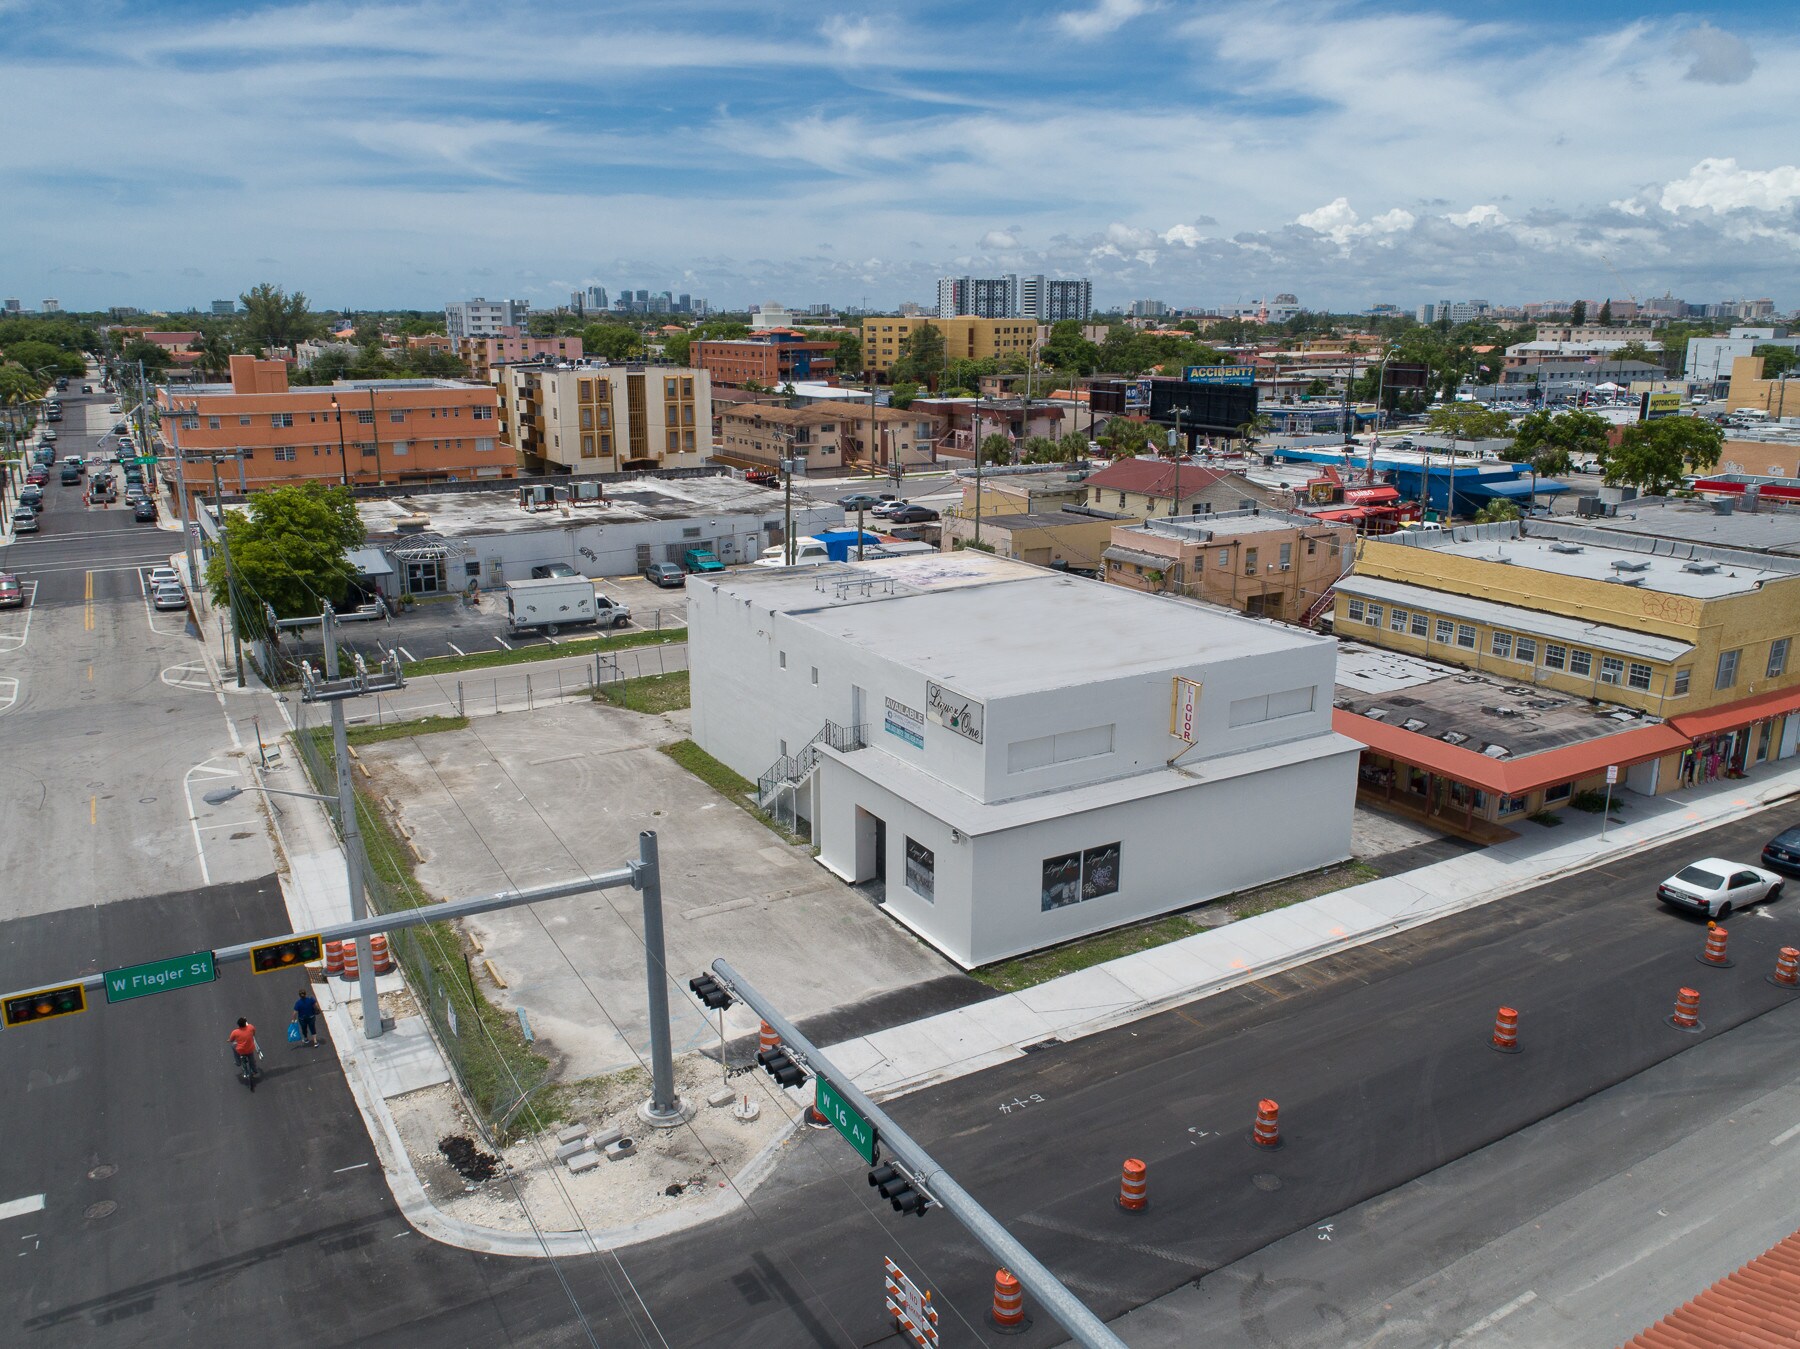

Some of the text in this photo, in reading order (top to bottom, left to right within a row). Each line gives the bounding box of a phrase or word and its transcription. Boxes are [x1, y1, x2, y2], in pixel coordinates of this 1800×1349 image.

[1190, 367, 1253, 378] ACCIDENT?
[886, 698, 924, 722] AVAILABLE
[1183, 686, 1193, 740] LIQUOR
[961, 712, 980, 739] One
[112, 962, 207, 992] W Flagler St
[823, 1091, 866, 1145] W 16 Av
